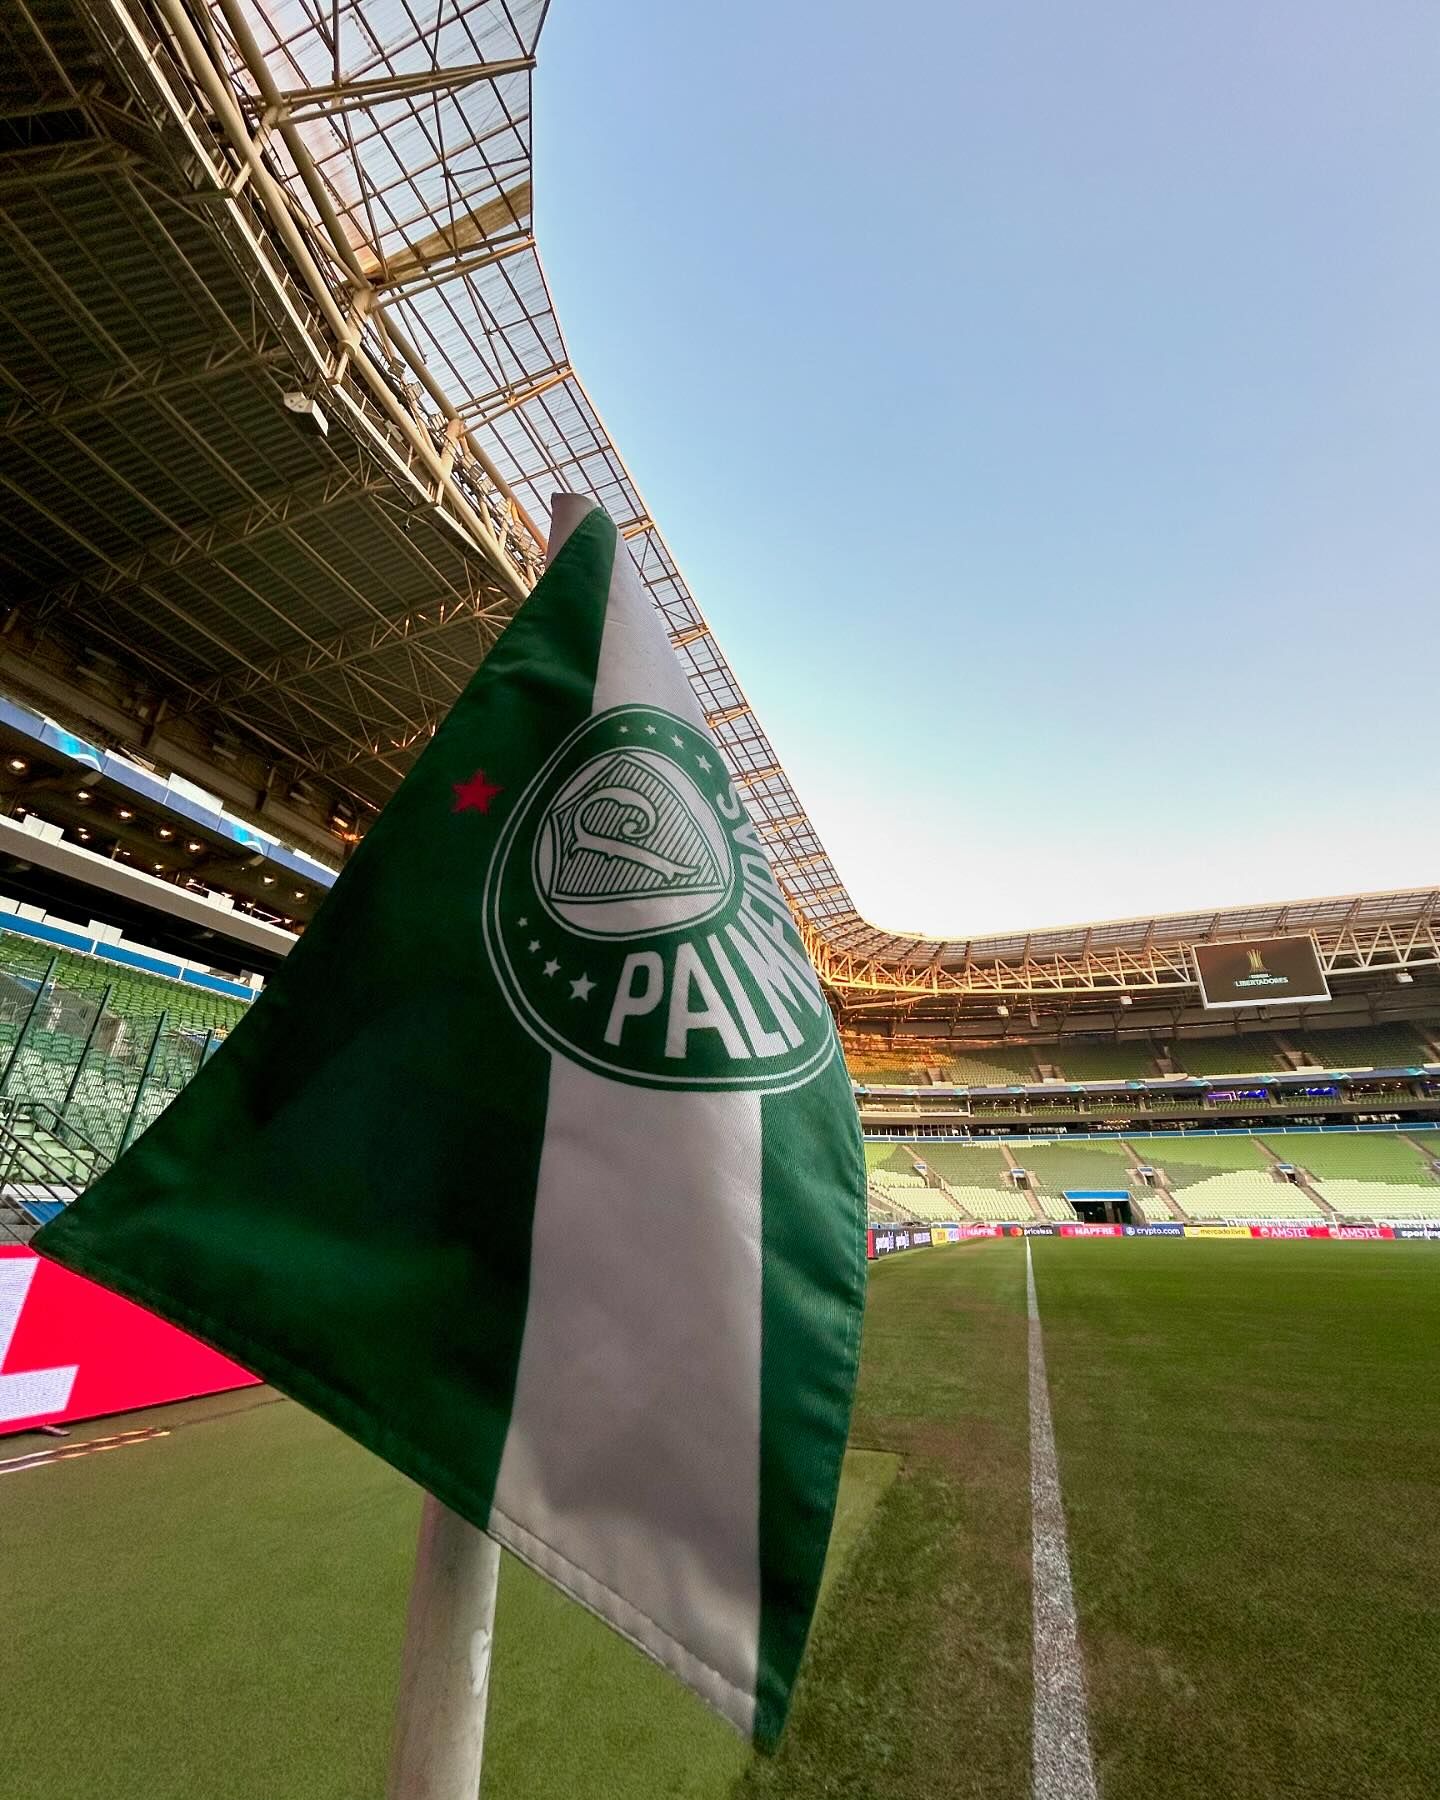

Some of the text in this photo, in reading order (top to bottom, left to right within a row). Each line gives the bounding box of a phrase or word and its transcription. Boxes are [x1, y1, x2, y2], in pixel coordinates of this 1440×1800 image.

[1075, 1227, 1115, 1235] MAPFRE
[1137, 1227, 1180, 1236] crypto.com
[1271, 1228, 1311, 1237] AMSTEL
[1340, 1228, 1383, 1238] AMSTEL
